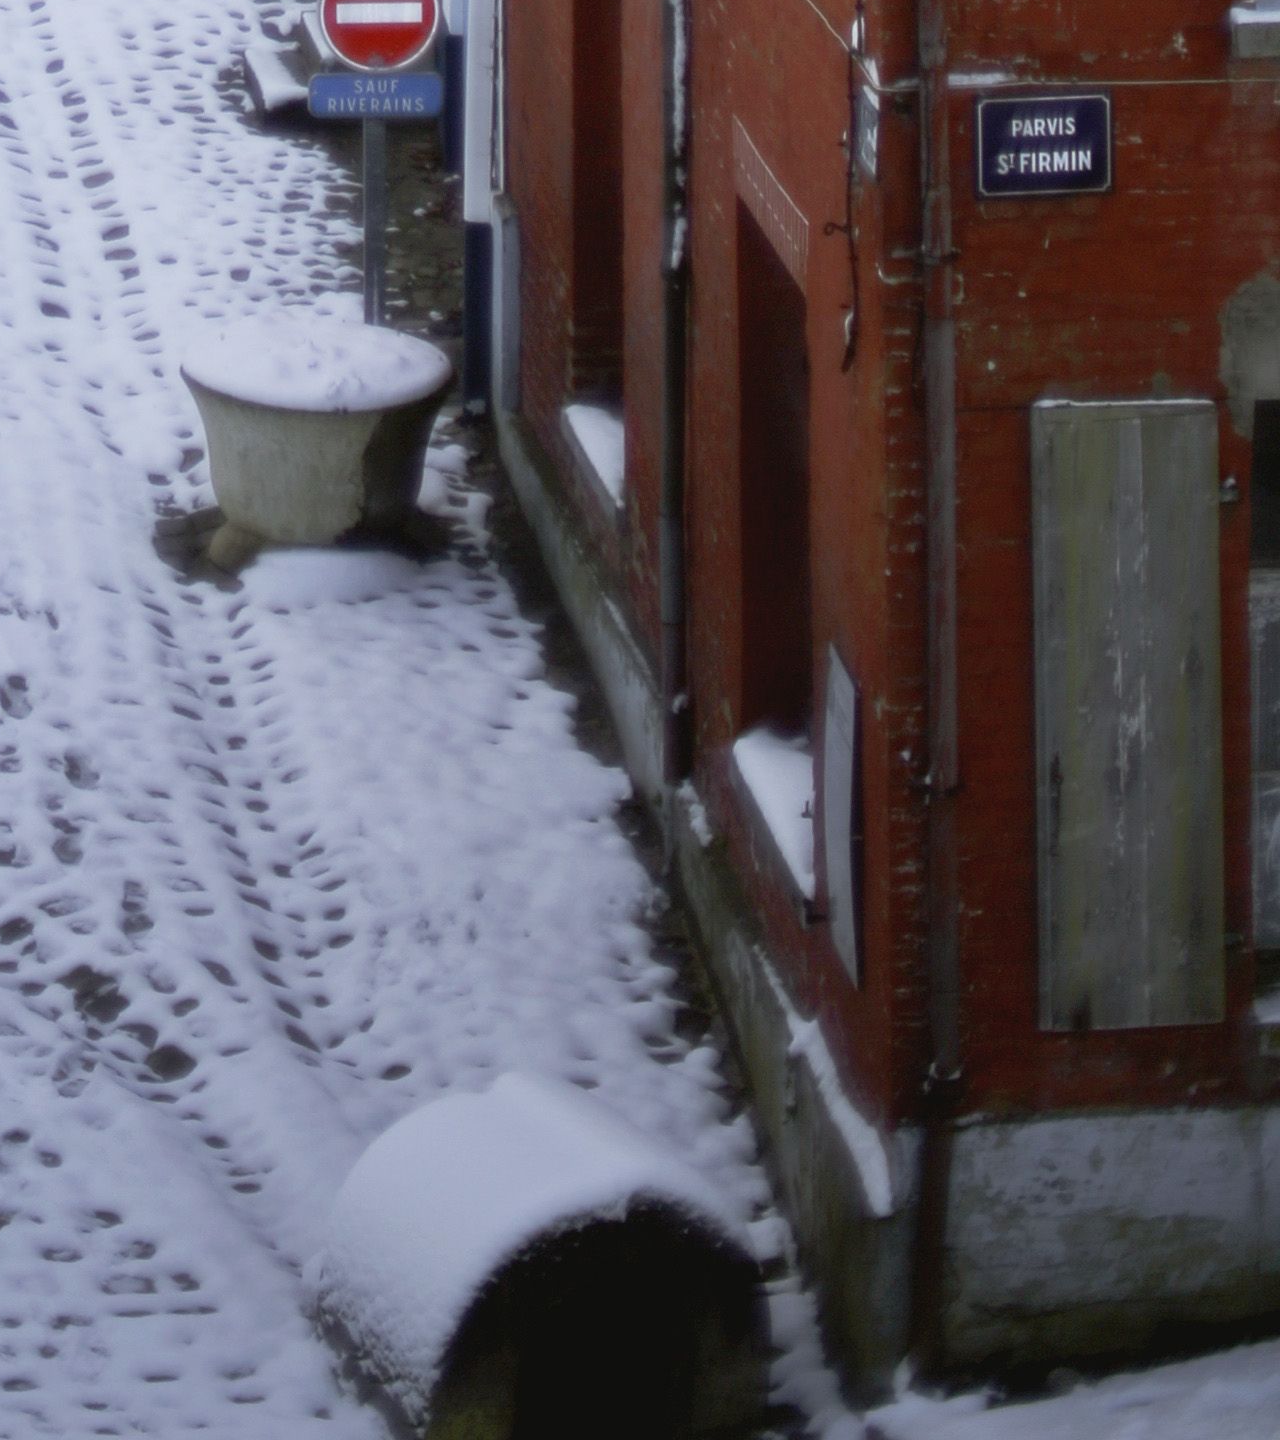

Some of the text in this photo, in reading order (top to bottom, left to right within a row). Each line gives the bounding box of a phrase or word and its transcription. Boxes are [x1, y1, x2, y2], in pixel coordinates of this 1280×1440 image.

[354, 79, 399, 94] SAUF
[327, 97, 425, 113] RIVERAINS
[1011, 117, 1076, 138] PARVIS
[1019, 150, 1092, 174] FIRMIN
